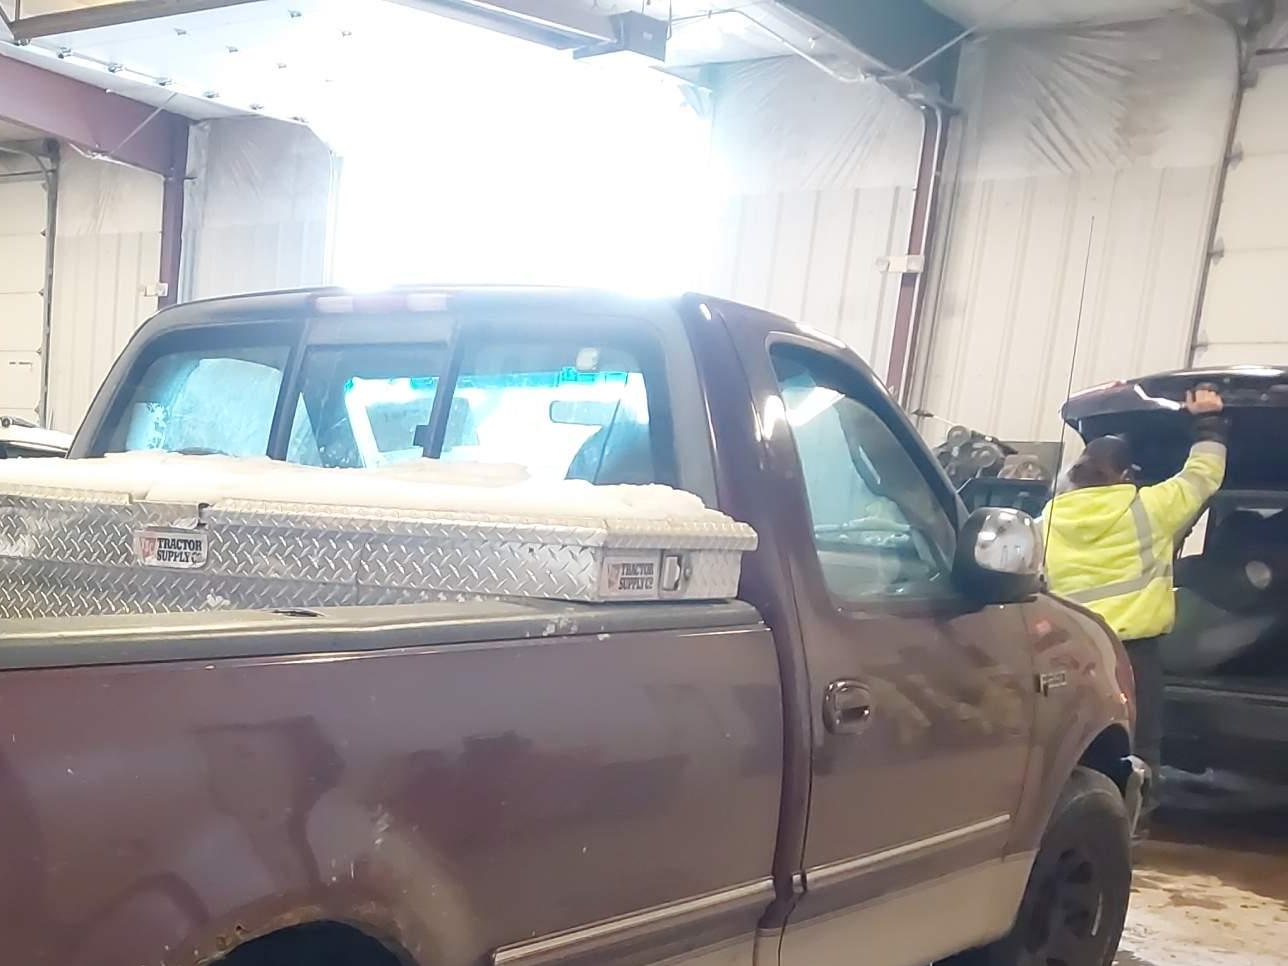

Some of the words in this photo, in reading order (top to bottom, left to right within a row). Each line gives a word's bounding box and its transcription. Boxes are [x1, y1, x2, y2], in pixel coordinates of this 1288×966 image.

[157, 537, 202, 552] TRACTOR
[157, 549, 190, 563] SUPPLY
[621, 562, 654, 576] TRACTOR
[618, 576, 644, 590] SUPPLY
